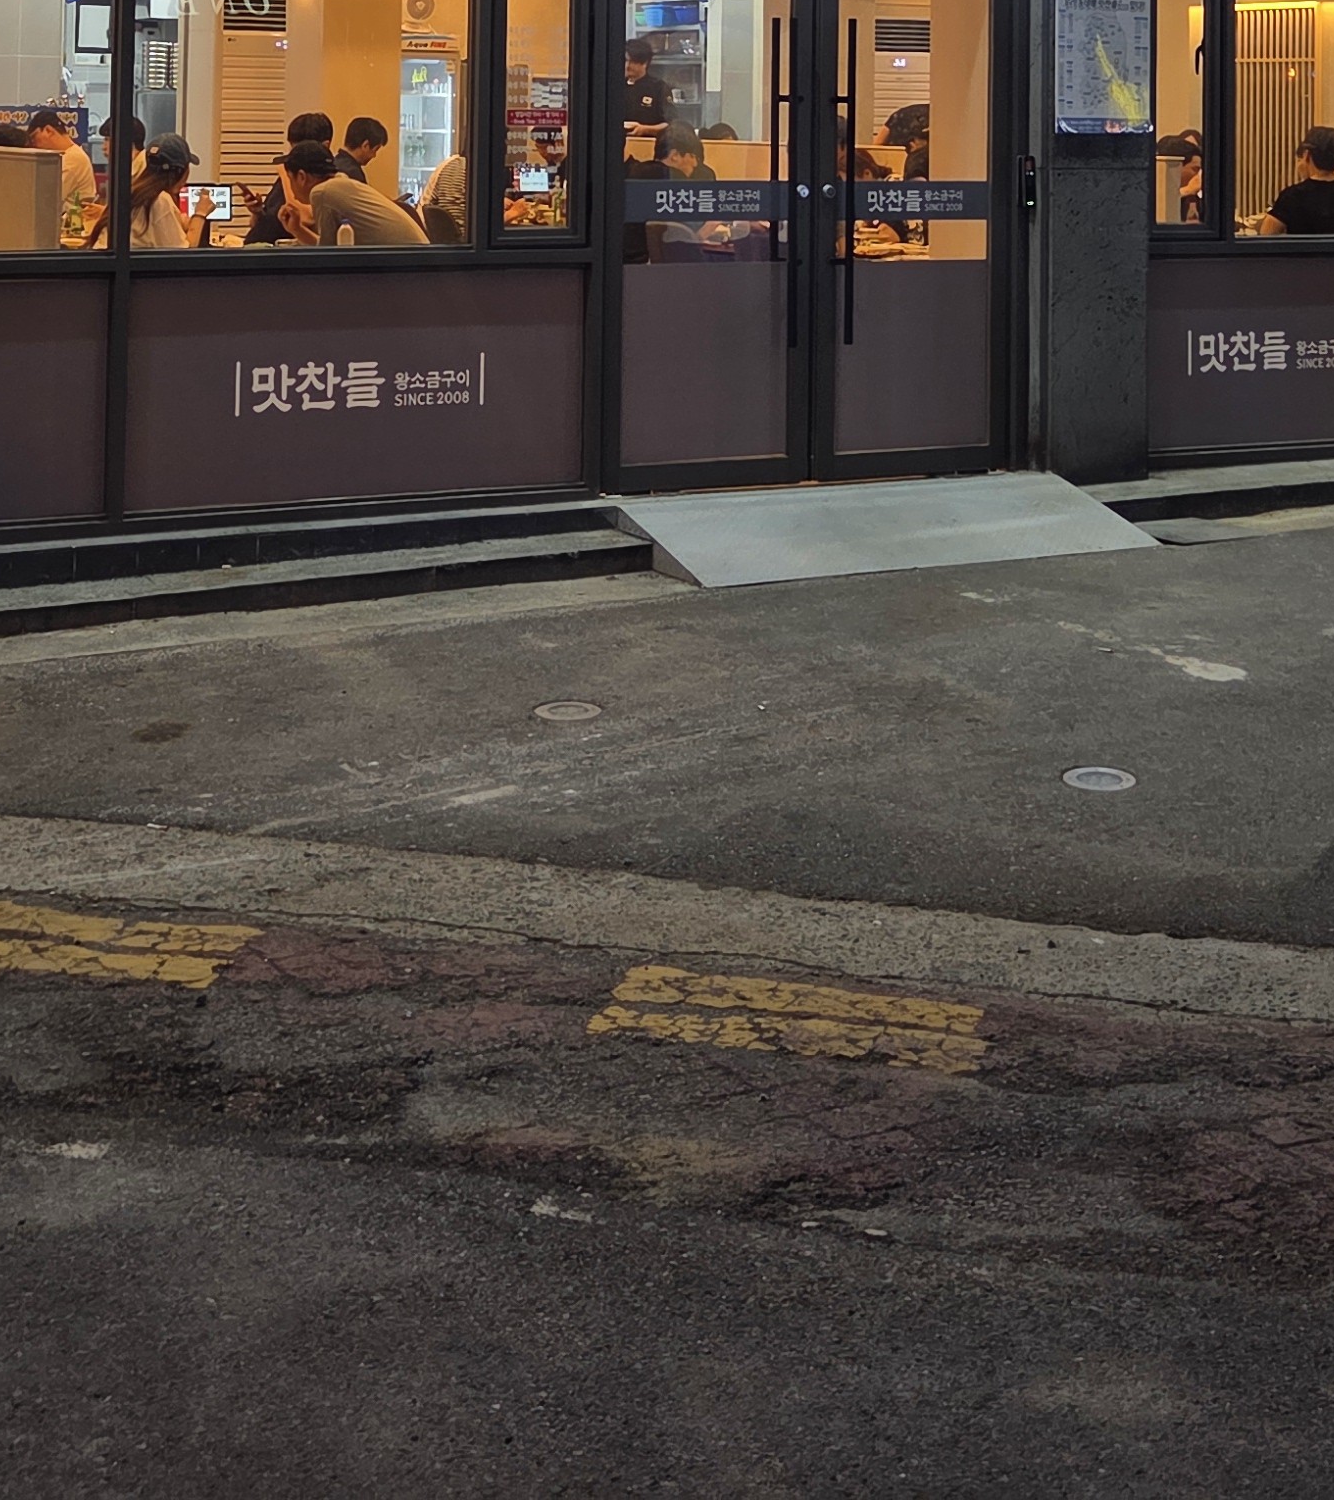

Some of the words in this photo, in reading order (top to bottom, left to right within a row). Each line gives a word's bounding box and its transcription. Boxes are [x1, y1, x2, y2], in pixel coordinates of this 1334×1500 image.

[656, 189, 717, 214] 맛찬들
[718, 189, 761, 201] 왕소금구이
[867, 189, 923, 213] 맛찬들
[924, 190, 964, 201] 왕소금구이
[1198, 330, 1291, 373] 맛찬들
[1296, 357, 1324, 369] SINCE
[251, 361, 386, 413] 맛찬들
[393, 369, 470, 391] 왕소금구이
[393, 392, 434, 407] SINCE
[436, 390, 470, 405] 2008
